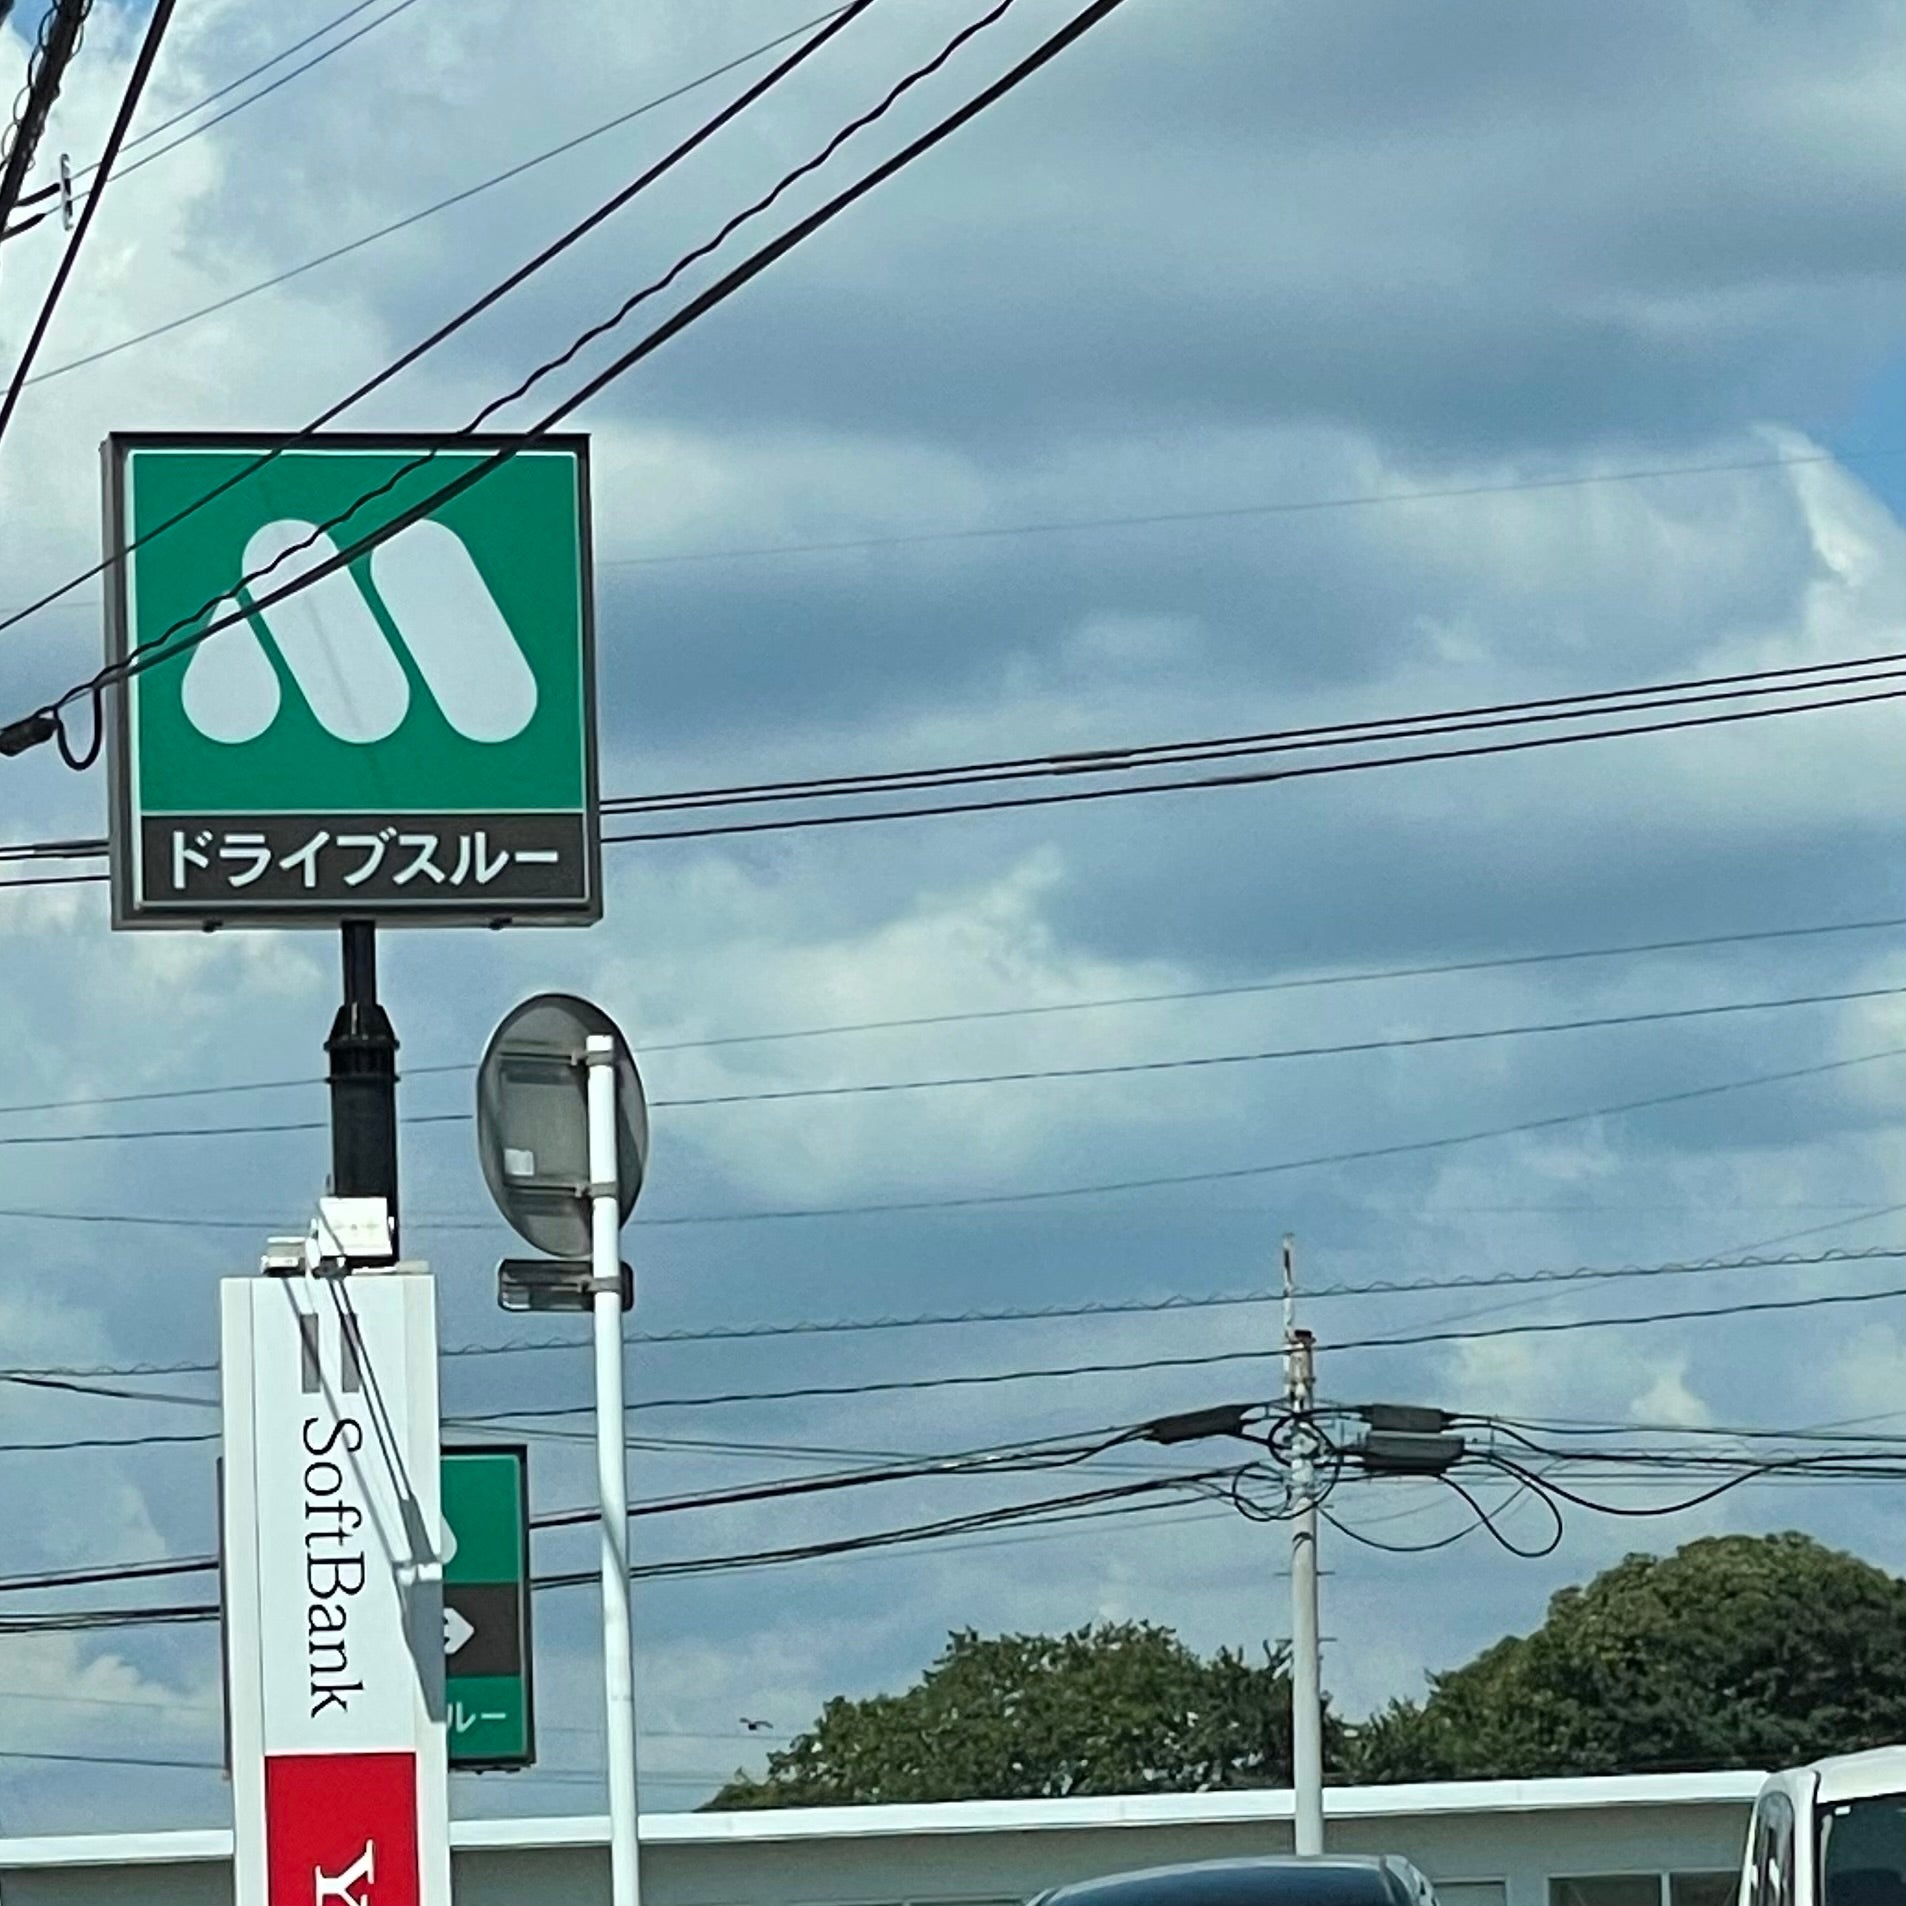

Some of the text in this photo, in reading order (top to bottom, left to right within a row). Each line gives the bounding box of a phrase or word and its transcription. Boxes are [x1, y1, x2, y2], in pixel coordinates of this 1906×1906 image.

[172, 826, 559, 889] ドライブスルー
[302, 1417, 365, 1719] SoftBank
